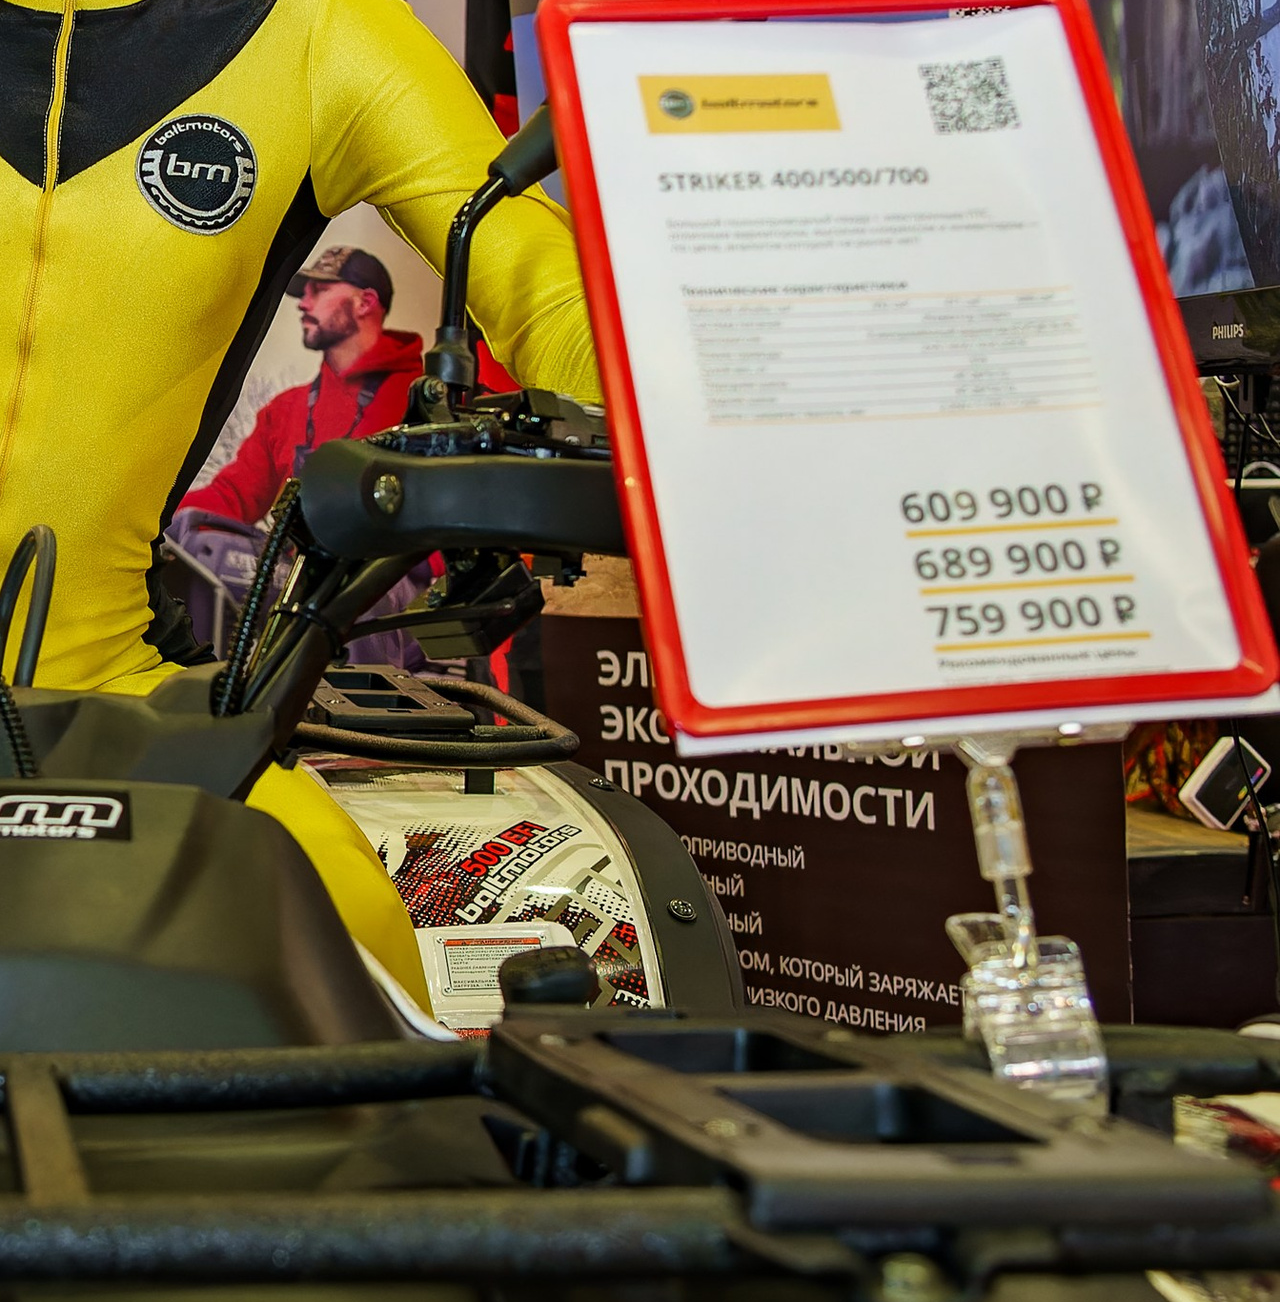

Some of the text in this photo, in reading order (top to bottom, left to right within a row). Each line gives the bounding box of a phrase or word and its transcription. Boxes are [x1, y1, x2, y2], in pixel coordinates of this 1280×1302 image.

[154, 121, 244, 152] baltmotors
[166, 153, 231, 182] bm
[658, 167, 930, 193] STRIKER 400/500/700
[1212, 323, 1244, 339] PHILIPS
[901, 490, 978, 523] 609
[989, 483, 1068, 518] 900
[914, 547, 992, 580] 689
[1006, 540, 1087, 575] 900
[925, 603, 1005, 637] 759
[1020, 596, 1101, 631] 900
[604, 759, 936, 831] ПРОХОДИМОСТИ
[460, 820, 550, 878] 500 EFI
[680, 835, 805, 870] ОПРИВОДНЫЙ
[454, 824, 582, 923] baltmotors
[738, 950, 968, 1008] ОМ, КОТОРЫЙ ЗАРЯЖАЕТ
[824, 1001, 926, 1032] ДАВЛЕНИЯ
